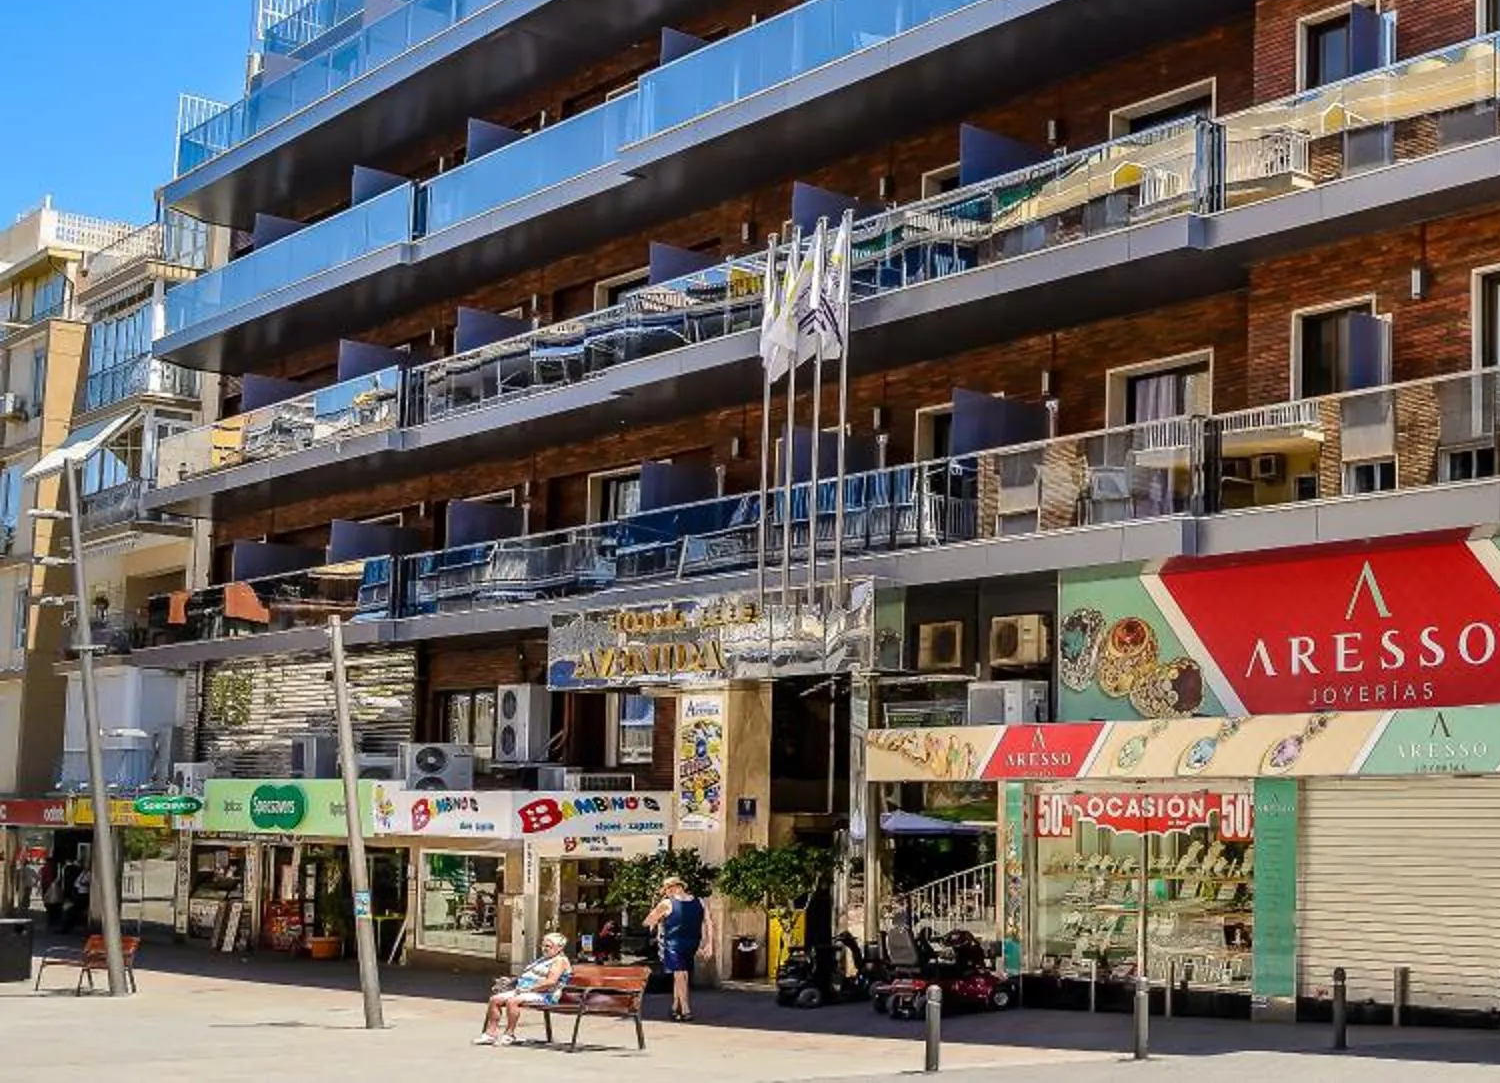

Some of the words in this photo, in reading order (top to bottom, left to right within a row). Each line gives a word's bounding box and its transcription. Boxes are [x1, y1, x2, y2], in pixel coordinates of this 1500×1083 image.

[574, 640, 728, 677] AVENIDA
[1245, 622, 1496, 677] ARESSO
[1309, 681, 1434, 704] JOYERÍAS
[1005, 750, 1072, 767] ARESSO
[1398, 741, 1488, 758] ARESSO
[1087, 792, 1205, 818] OCASIÓN
